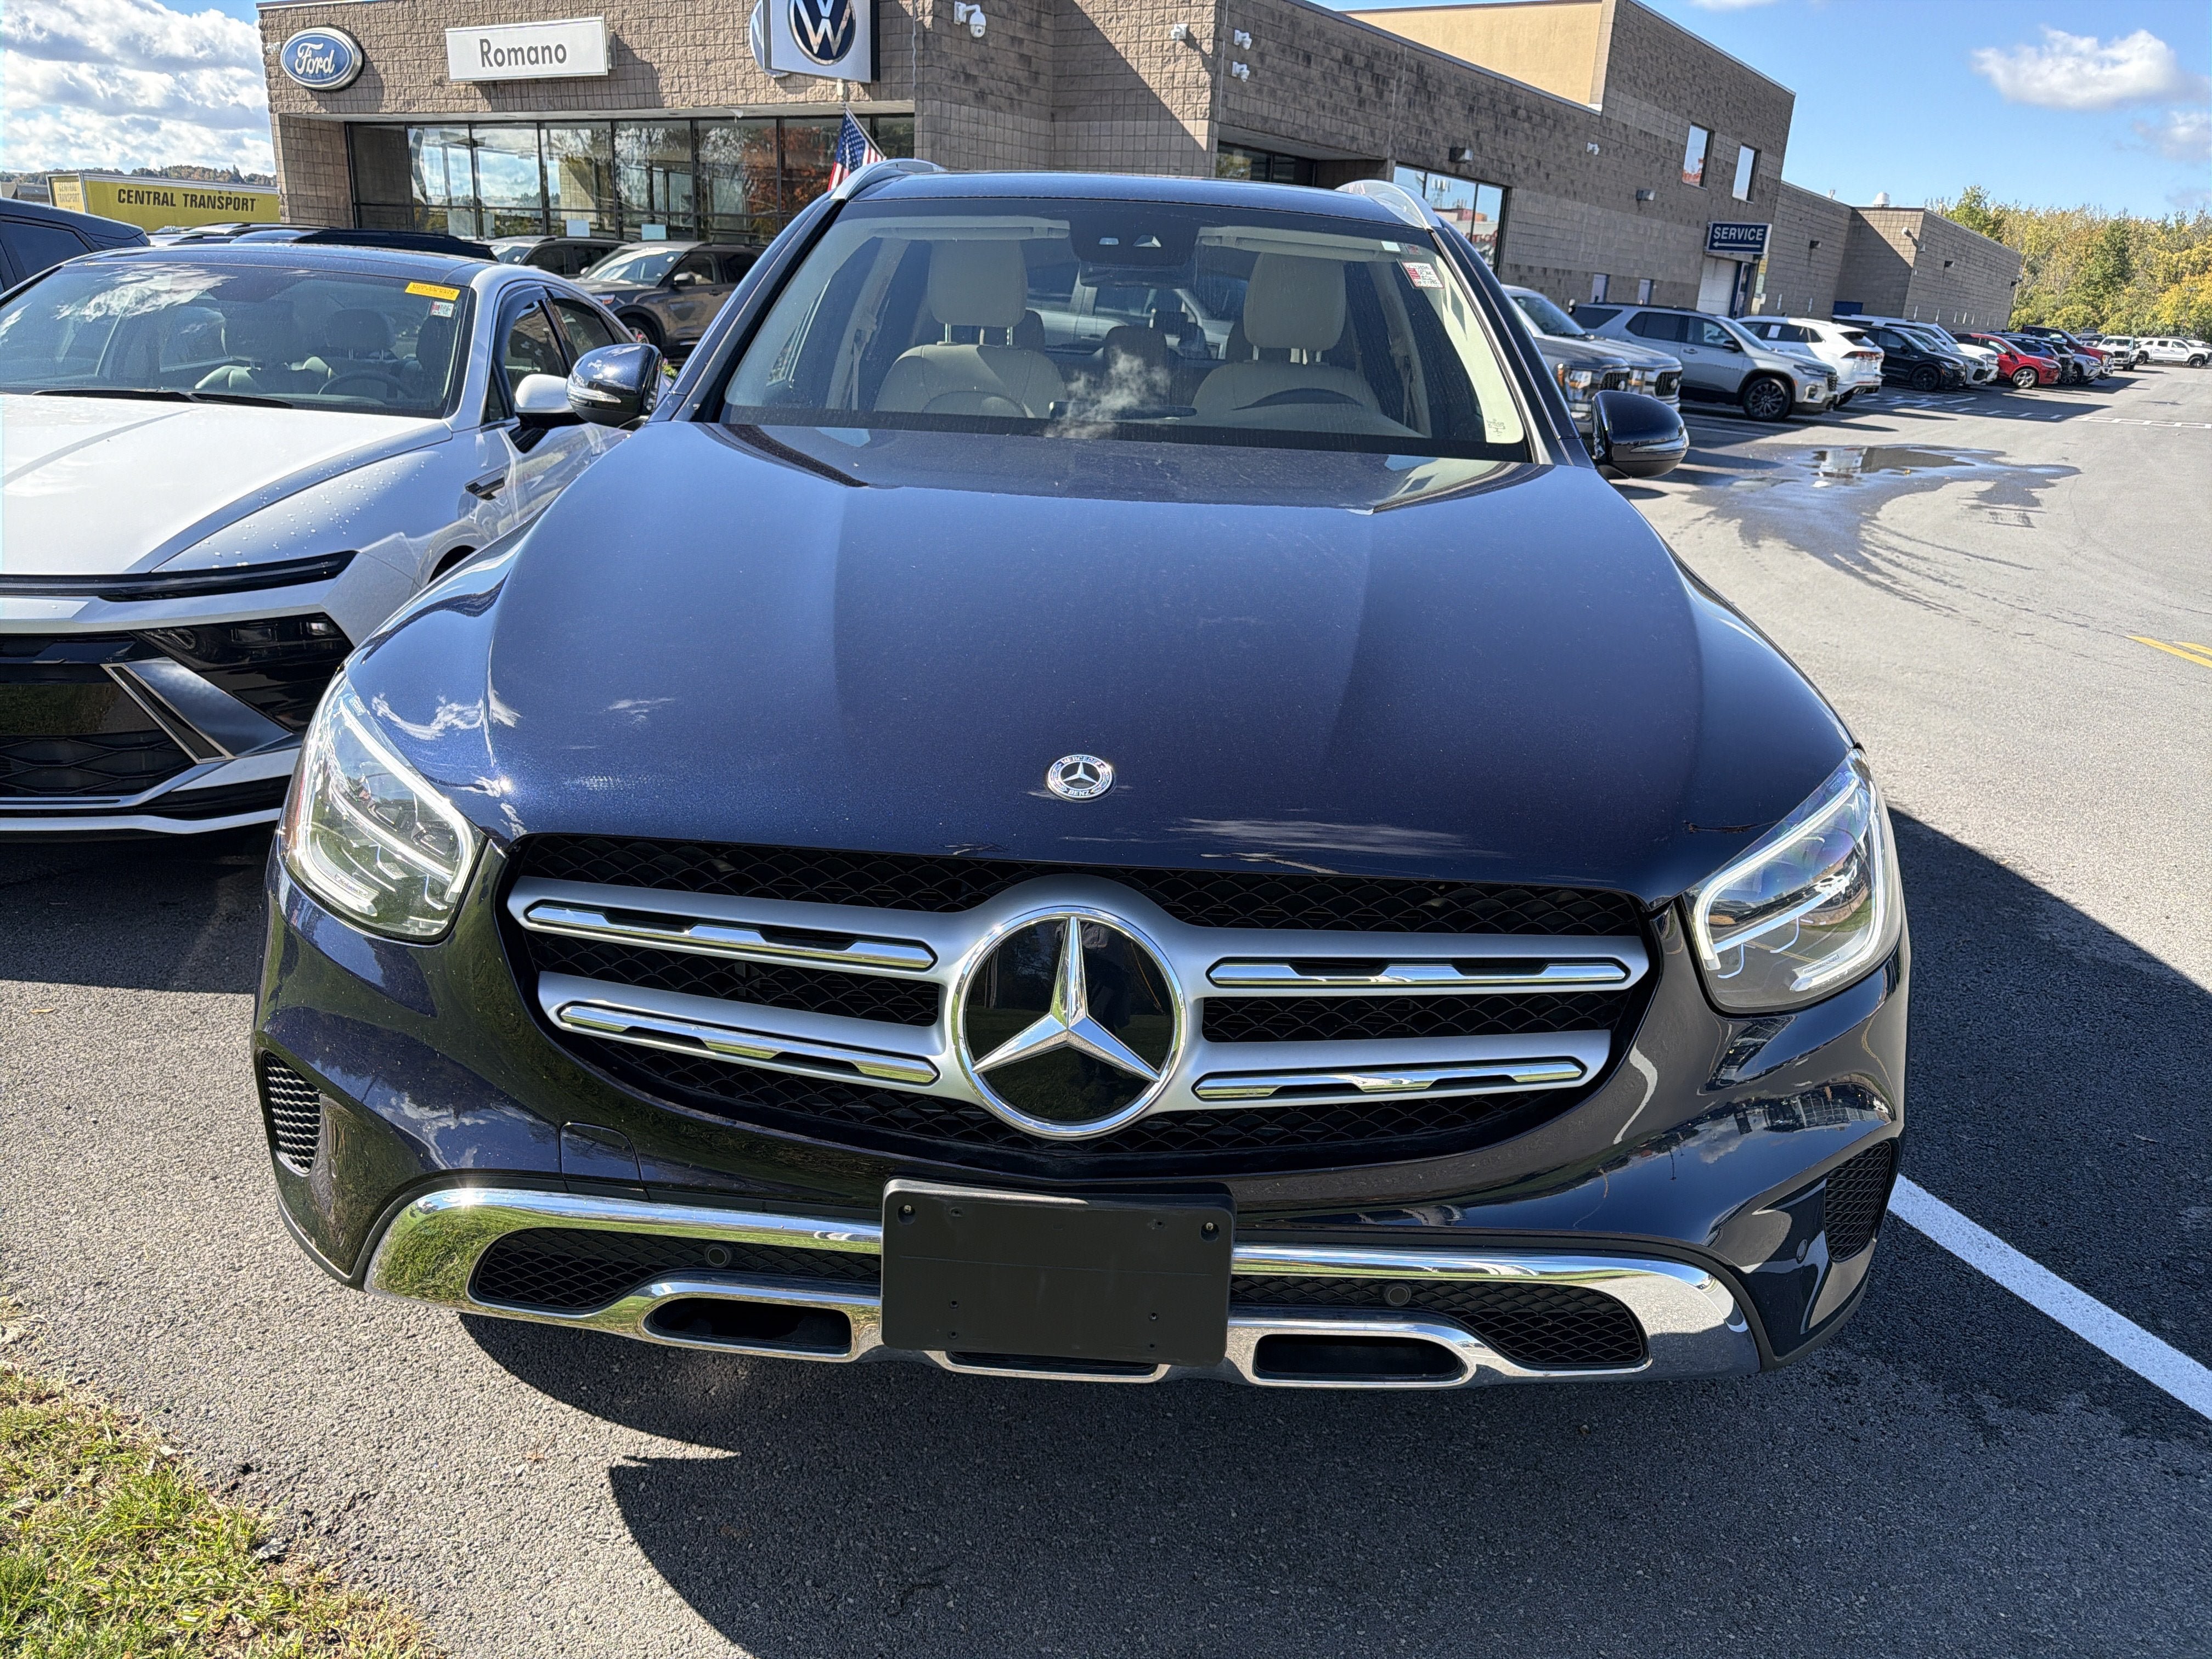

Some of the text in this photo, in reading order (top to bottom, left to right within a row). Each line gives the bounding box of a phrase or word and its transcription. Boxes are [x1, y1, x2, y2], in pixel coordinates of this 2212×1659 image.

[295, 42, 335, 75] Ford
[479, 38, 567, 67] Romano
[117, 188, 256, 212] CENTRAL TRANSPORT
[1713, 226, 1764, 241] SERVICE
